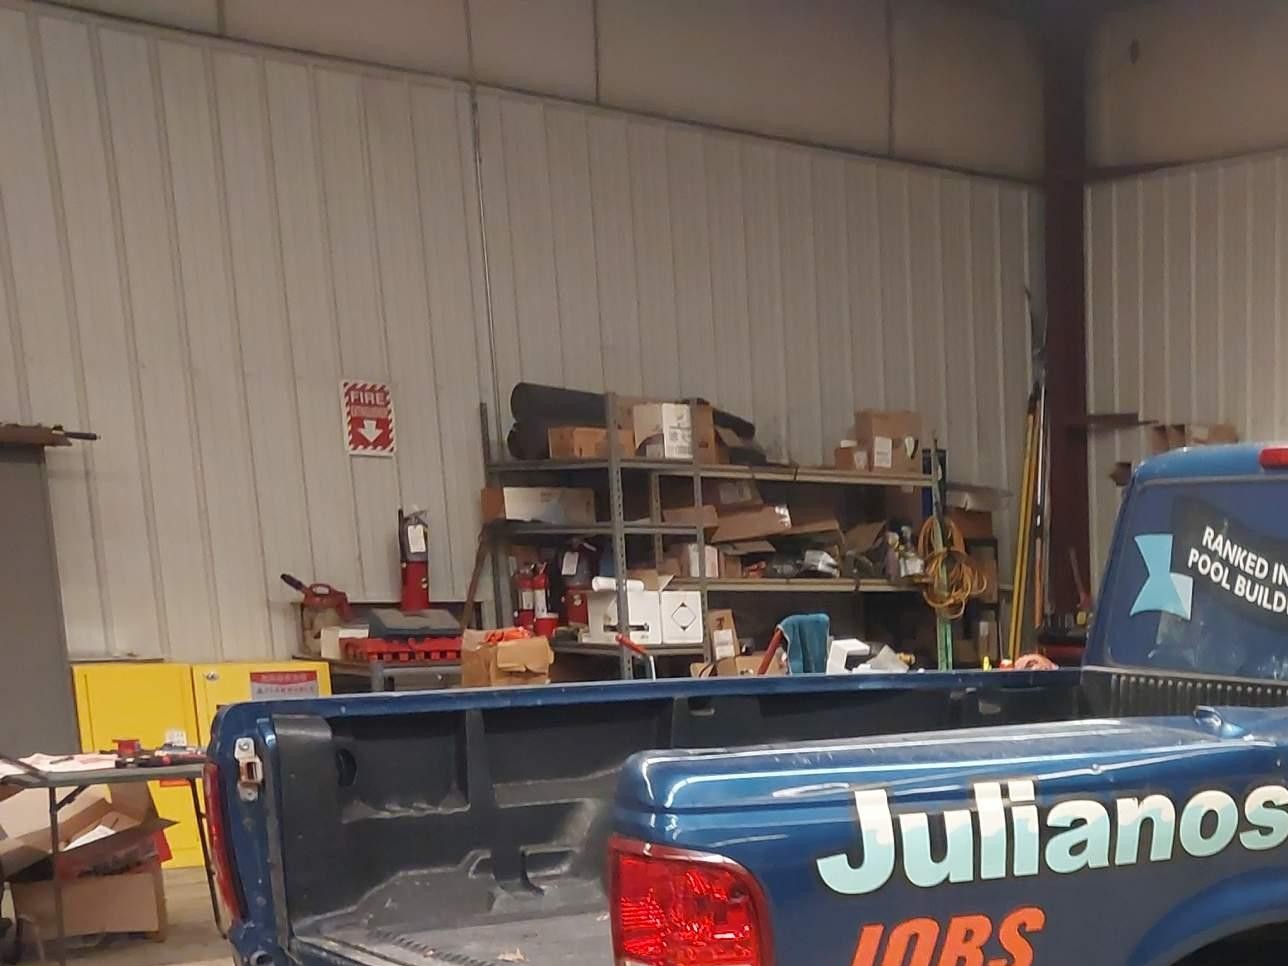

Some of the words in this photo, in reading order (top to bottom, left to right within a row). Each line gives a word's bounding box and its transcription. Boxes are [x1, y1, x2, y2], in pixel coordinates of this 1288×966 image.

[350, 390, 385, 406] FIRE
[1187, 547, 1231, 590] POOL
[1202, 525, 1269, 580] RANKED
